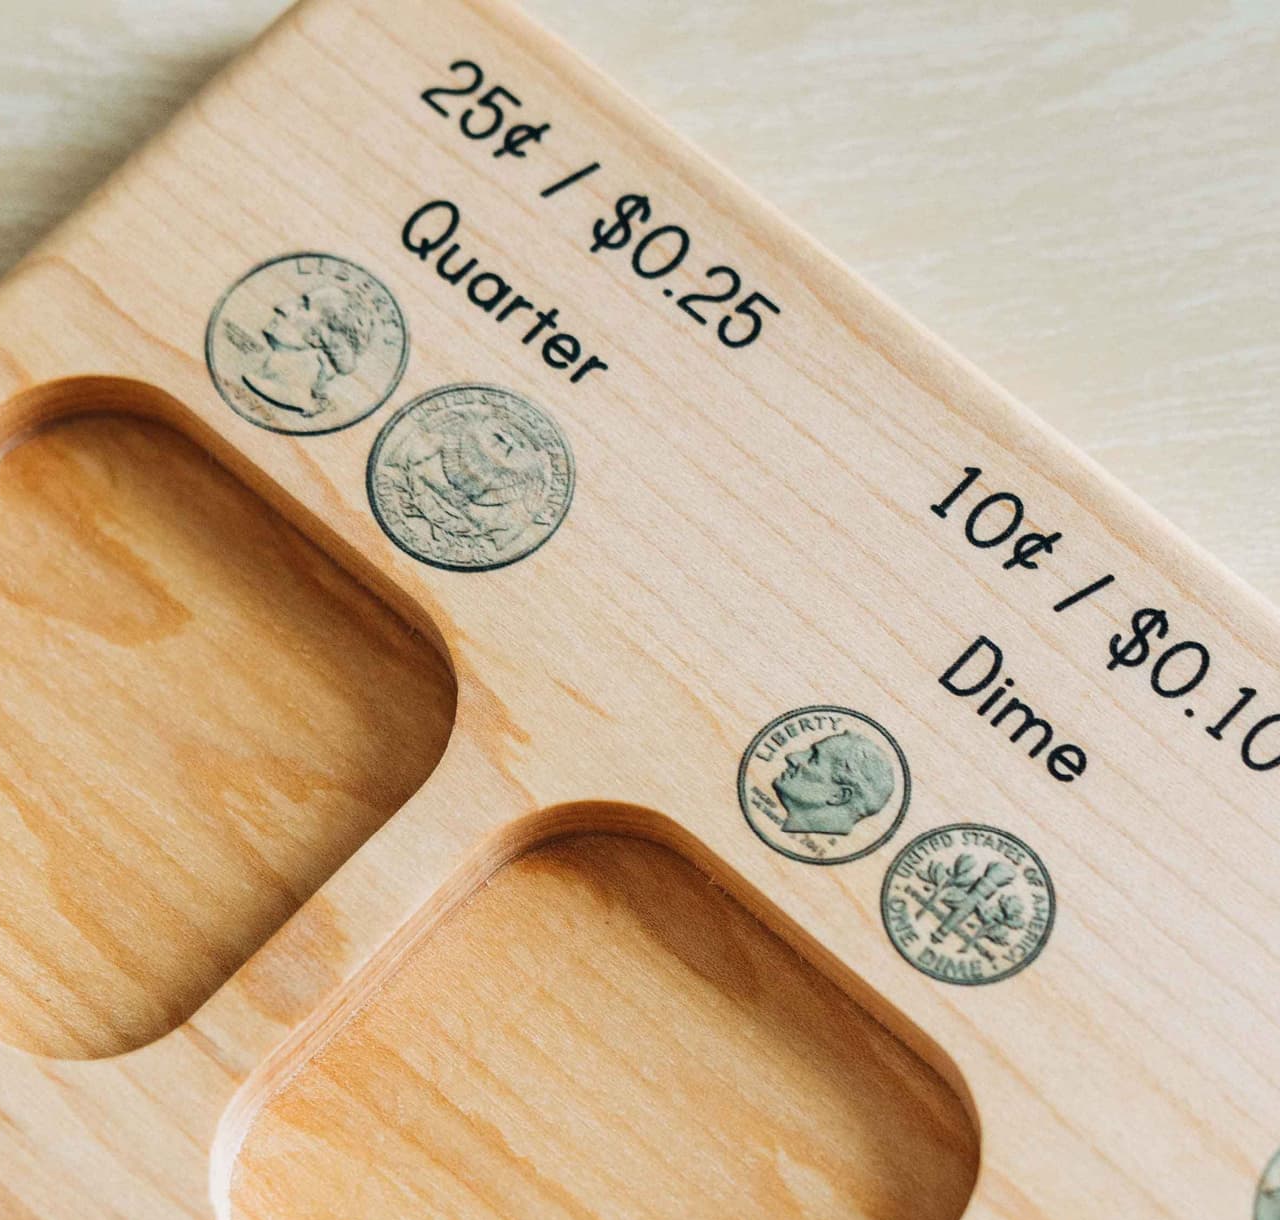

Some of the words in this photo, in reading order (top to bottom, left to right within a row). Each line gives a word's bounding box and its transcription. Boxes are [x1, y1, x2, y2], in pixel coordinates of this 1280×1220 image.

[420, 60, 551, 158] 25¢
[540, 162, 601, 198] /
[589, 193, 781, 349] $0.25
[401, 199, 609, 384] Quarter
[930, 466, 1063, 571] 10¢
[1052, 574, 1116, 613] /
[755, 715, 842, 762] LIBERTY
[937, 635, 1088, 783] Dime
[895, 831, 953, 879] UNITED
[961, 831, 1026, 866] STATES
[1023, 867, 1045, 888] OF
[889, 897, 920, 948] ONE
[918, 946, 984, 979] DIME
